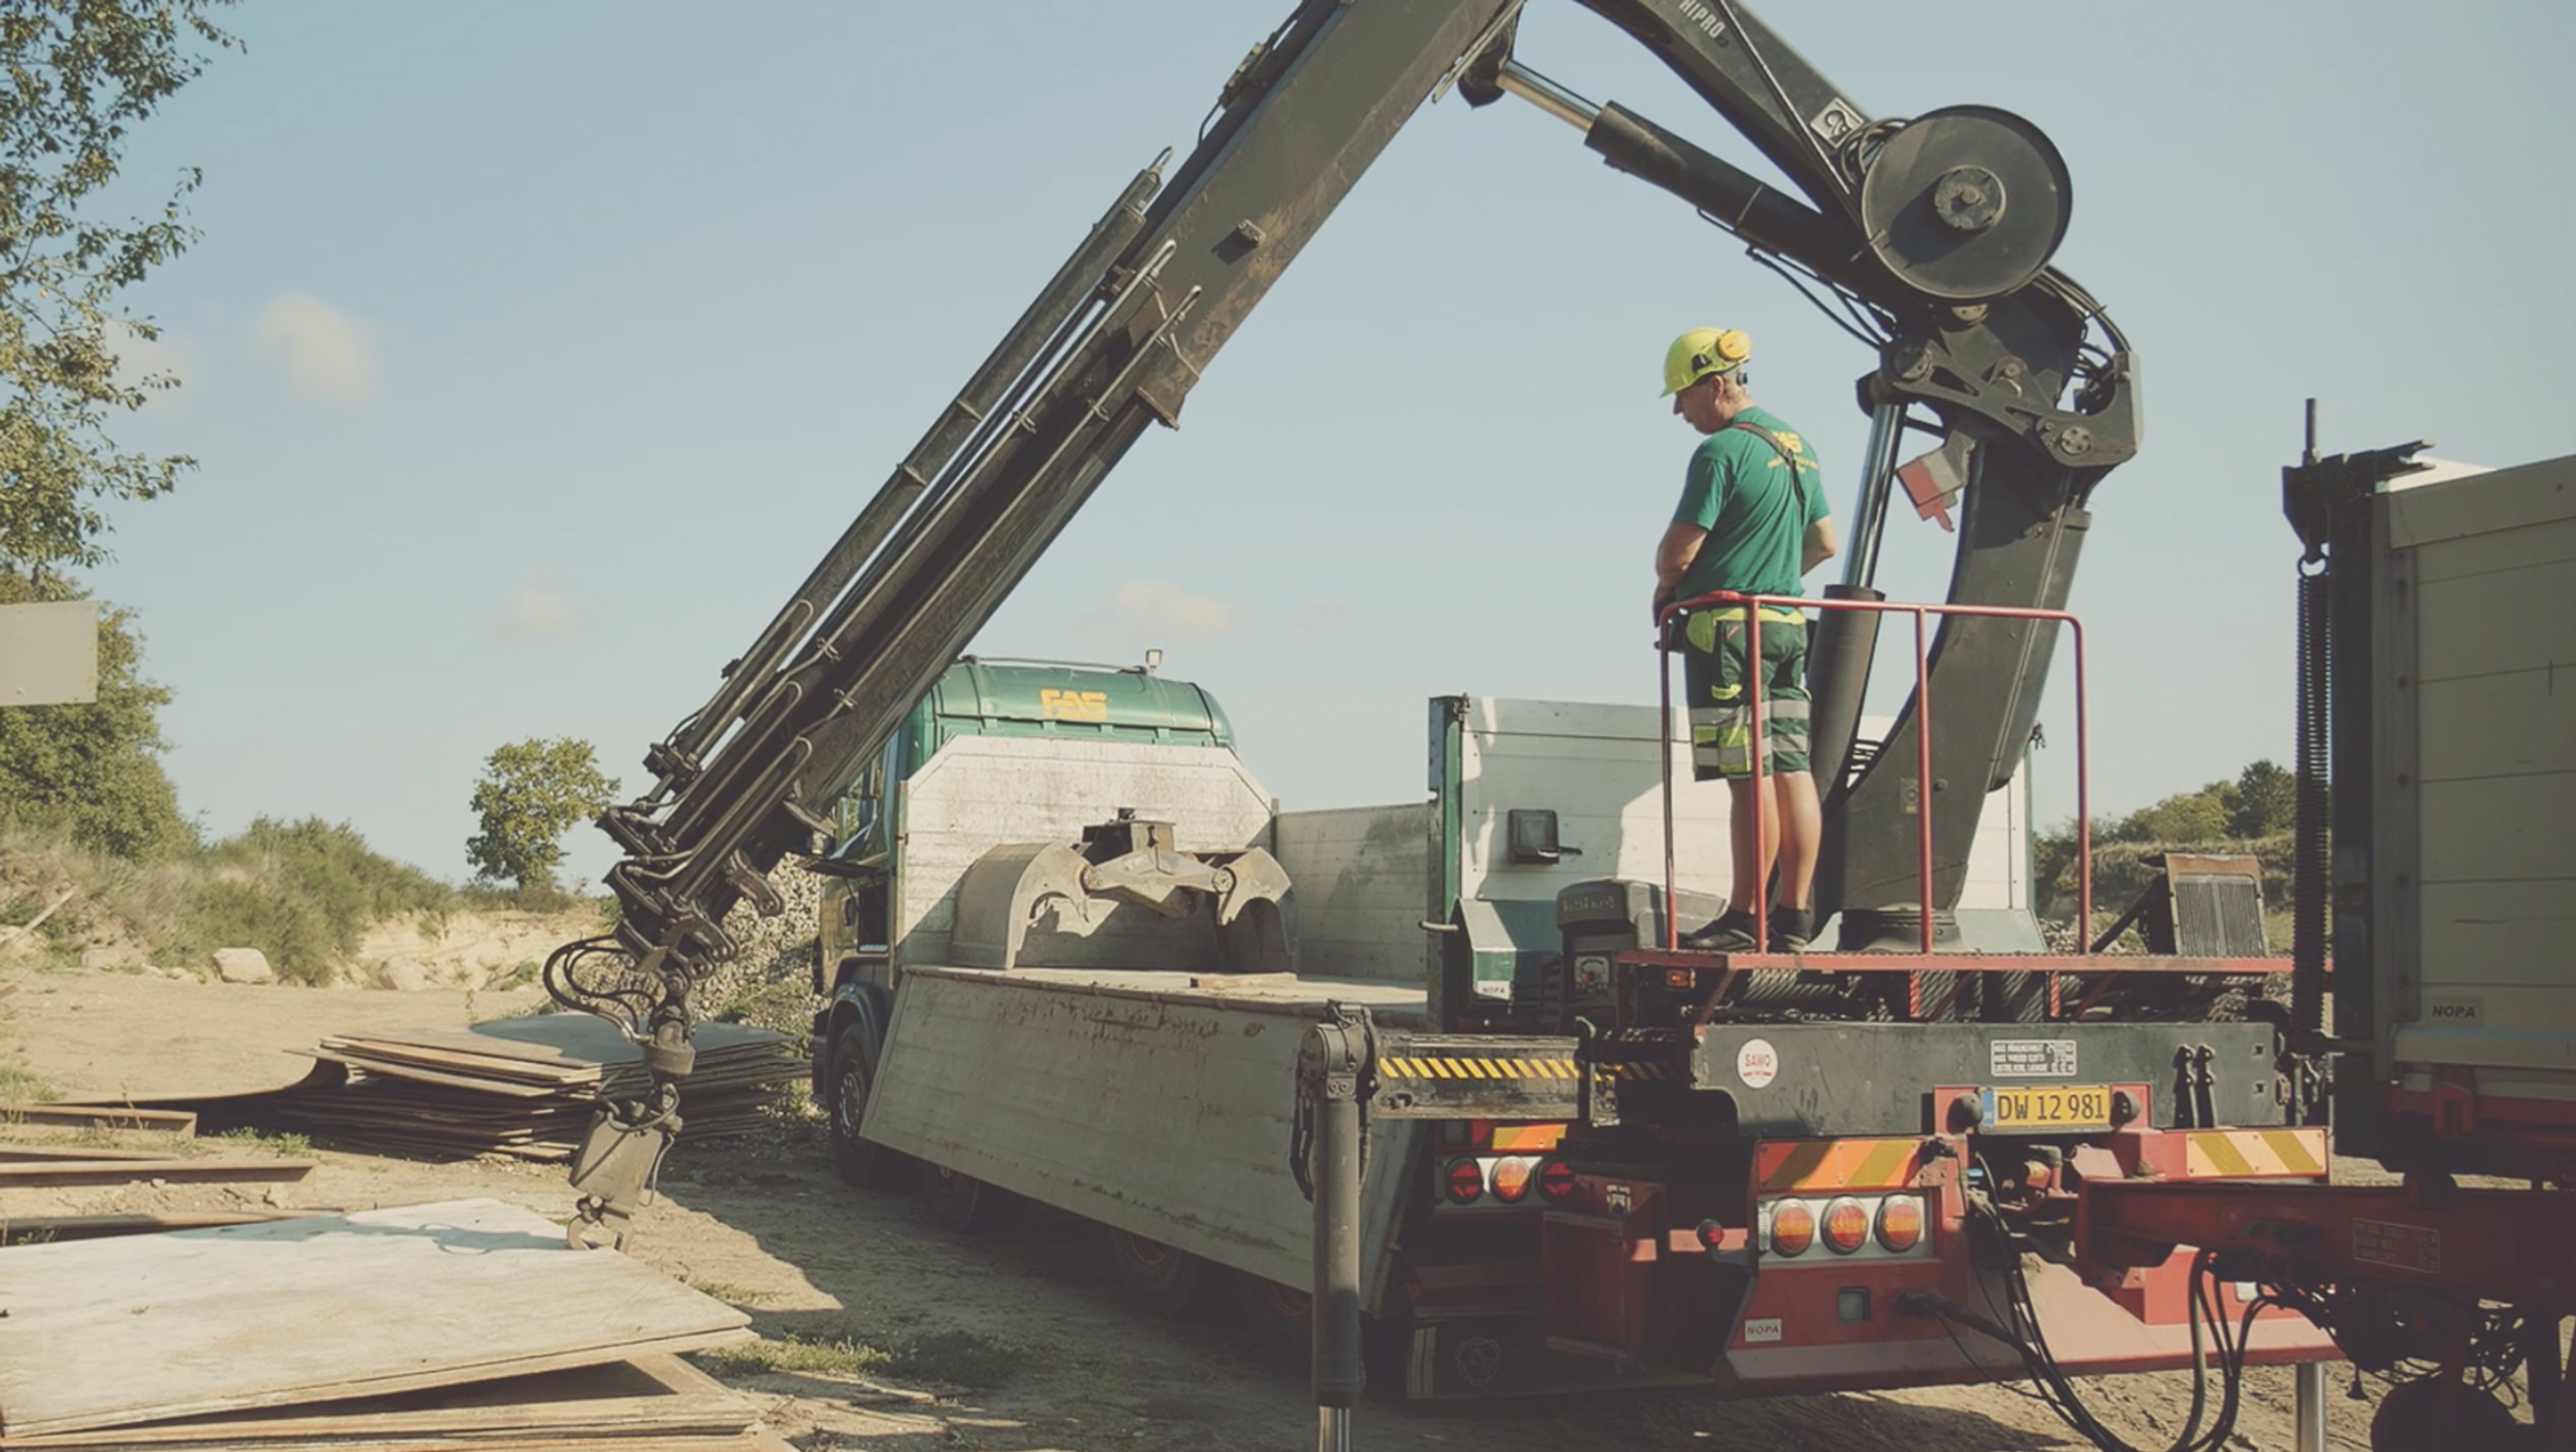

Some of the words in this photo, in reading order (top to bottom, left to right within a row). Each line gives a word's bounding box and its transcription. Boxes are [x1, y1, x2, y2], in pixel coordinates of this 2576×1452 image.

[1679, 0, 1726, 38] HIPRO
[1040, 688, 1107, 721] FAS
[2432, 1005, 2475, 1018] NOPA
[1997, 1095, 2029, 1120] DW
[2037, 1095, 2062, 1120] 12
[2067, 1093, 2104, 1120] 981
[1747, 1325, 1780, 1335] NOPA
